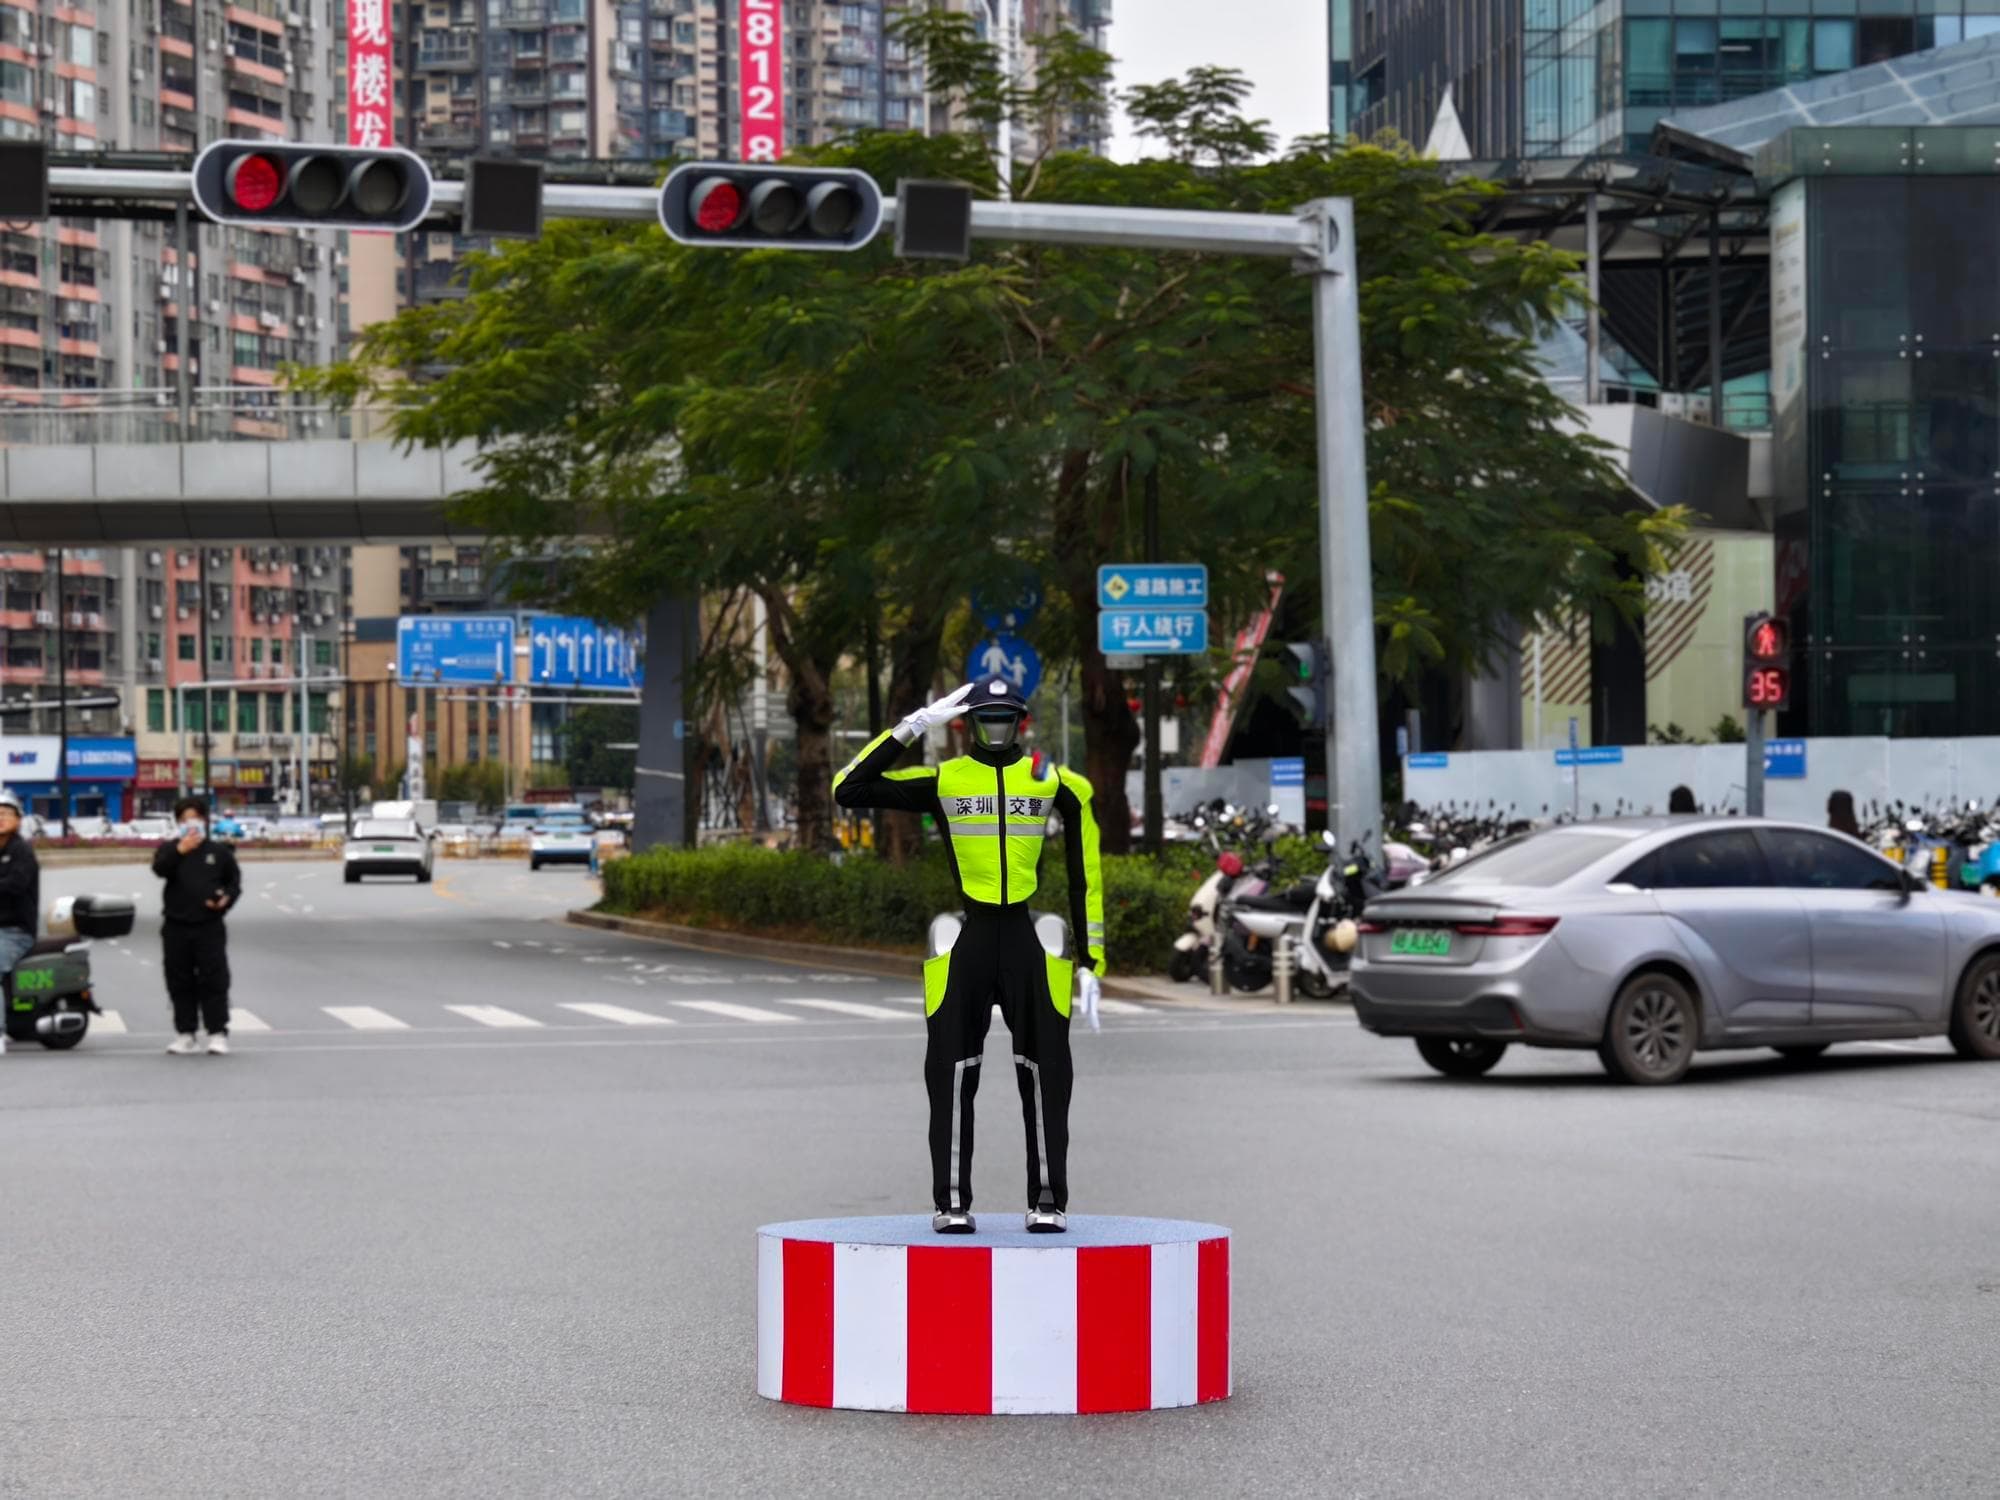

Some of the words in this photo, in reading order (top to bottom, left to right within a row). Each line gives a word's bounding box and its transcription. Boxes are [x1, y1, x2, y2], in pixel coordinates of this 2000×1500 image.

[1751, 671, 1782, 703] 35
[956, 797, 993, 815] 深圳
[1009, 797, 1043, 816] 交警
